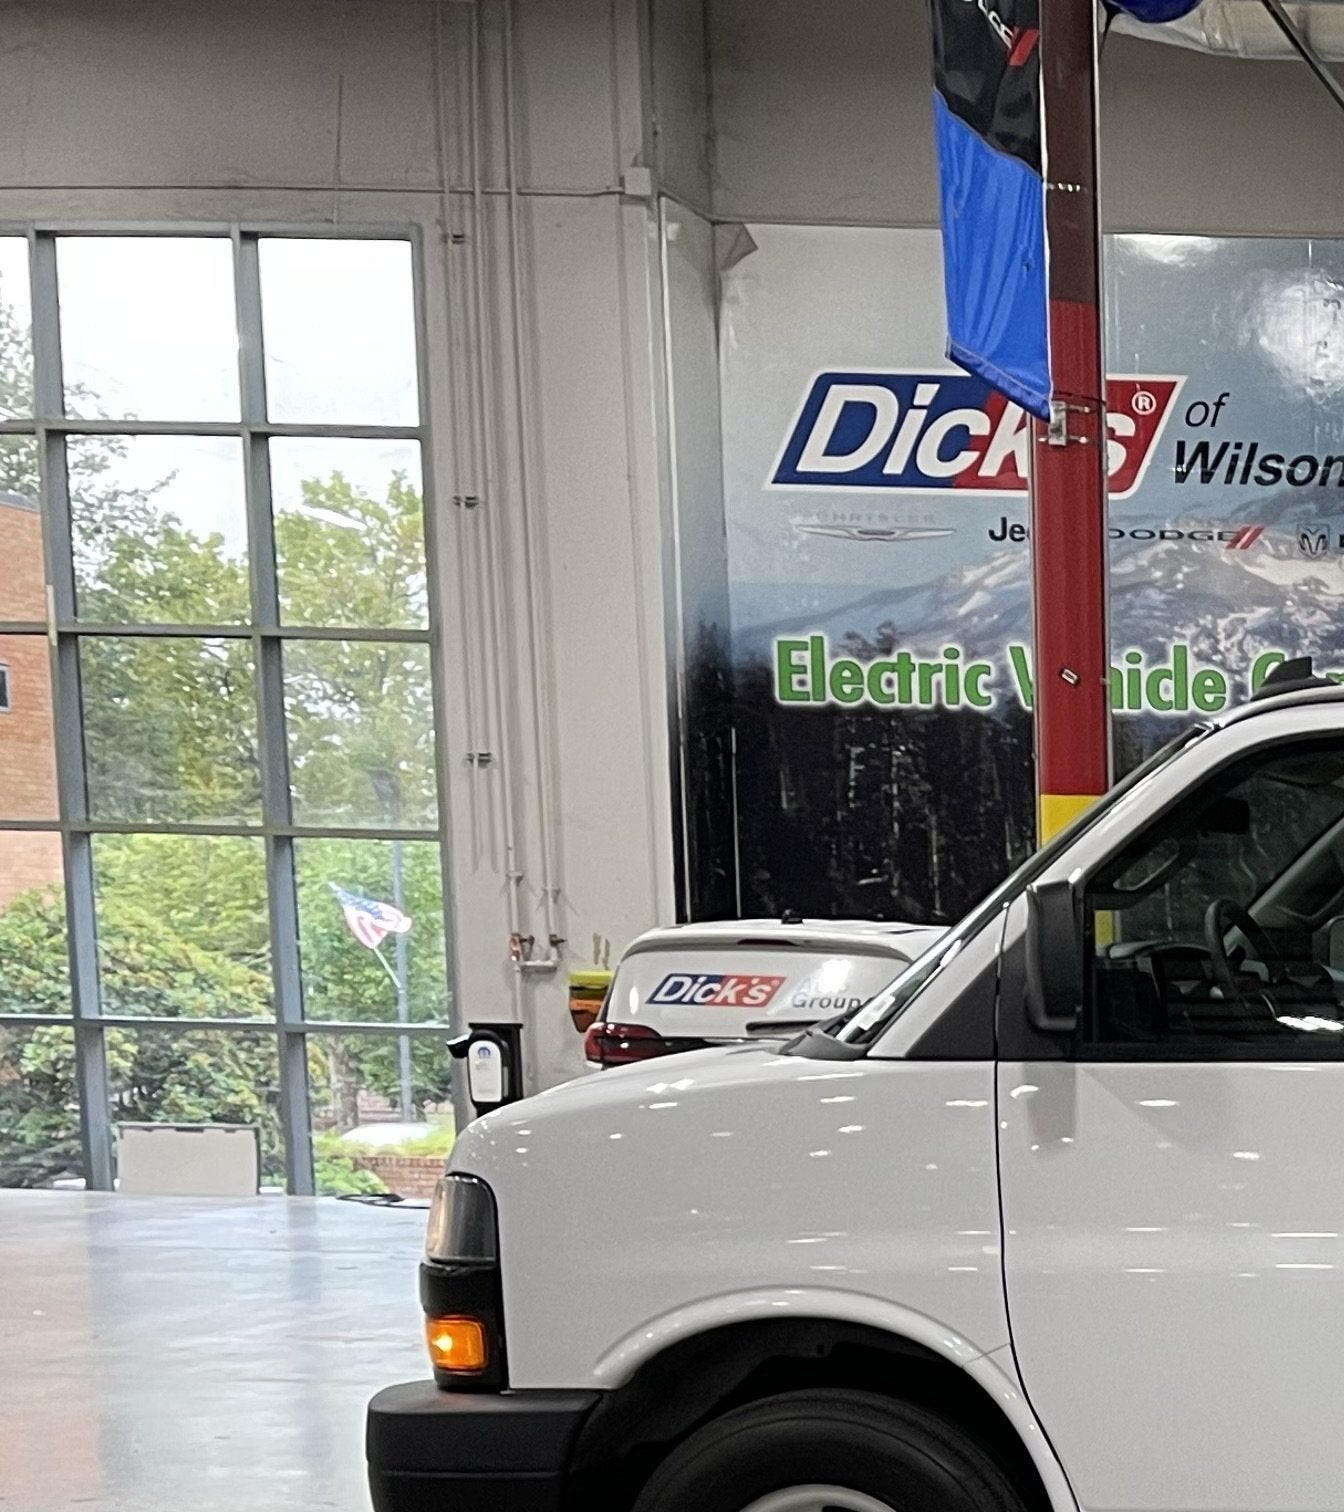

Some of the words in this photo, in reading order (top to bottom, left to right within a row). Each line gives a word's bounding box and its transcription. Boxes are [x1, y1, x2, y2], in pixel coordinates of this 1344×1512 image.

[796, 383, 1135, 478] Dicks
[1185, 392, 1229, 427] of
[988, 517, 1030, 542] Je
[777, 636, 992, 706] Electric
[1009, 645, 1227, 712] Vicle
[653, 976, 773, 1005] Dick's
